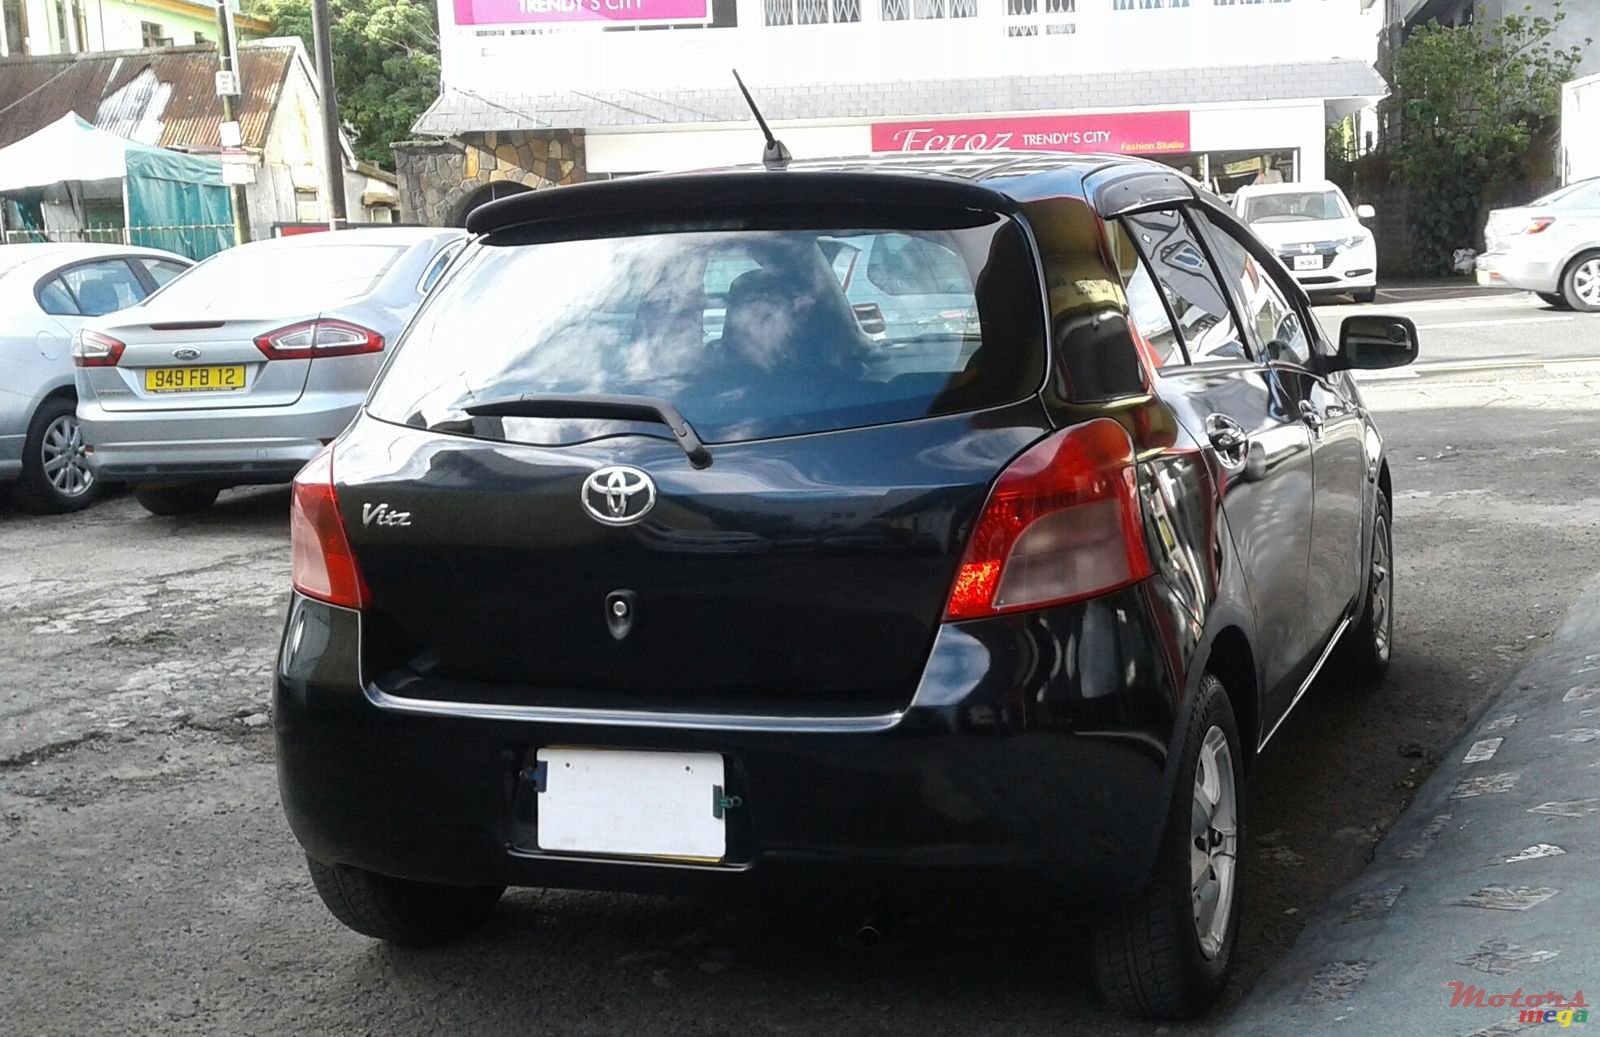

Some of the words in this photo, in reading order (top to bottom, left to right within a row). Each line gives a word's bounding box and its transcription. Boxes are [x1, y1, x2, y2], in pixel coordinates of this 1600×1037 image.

[518, 0, 601, 13] TRENDYS
[894, 128, 1013, 151] Feroz
[1022, 132, 1081, 146] TRENDY'S
[1083, 131, 1112, 144] CITY
[1120, 142, 1155, 151] Fashion
[1156, 141, 1184, 150] Studio
[155, 370, 184, 387] 949
[189, 369, 209, 386] FB
[218, 368, 235, 385] 12
[362, 502, 412, 528] Vitz
